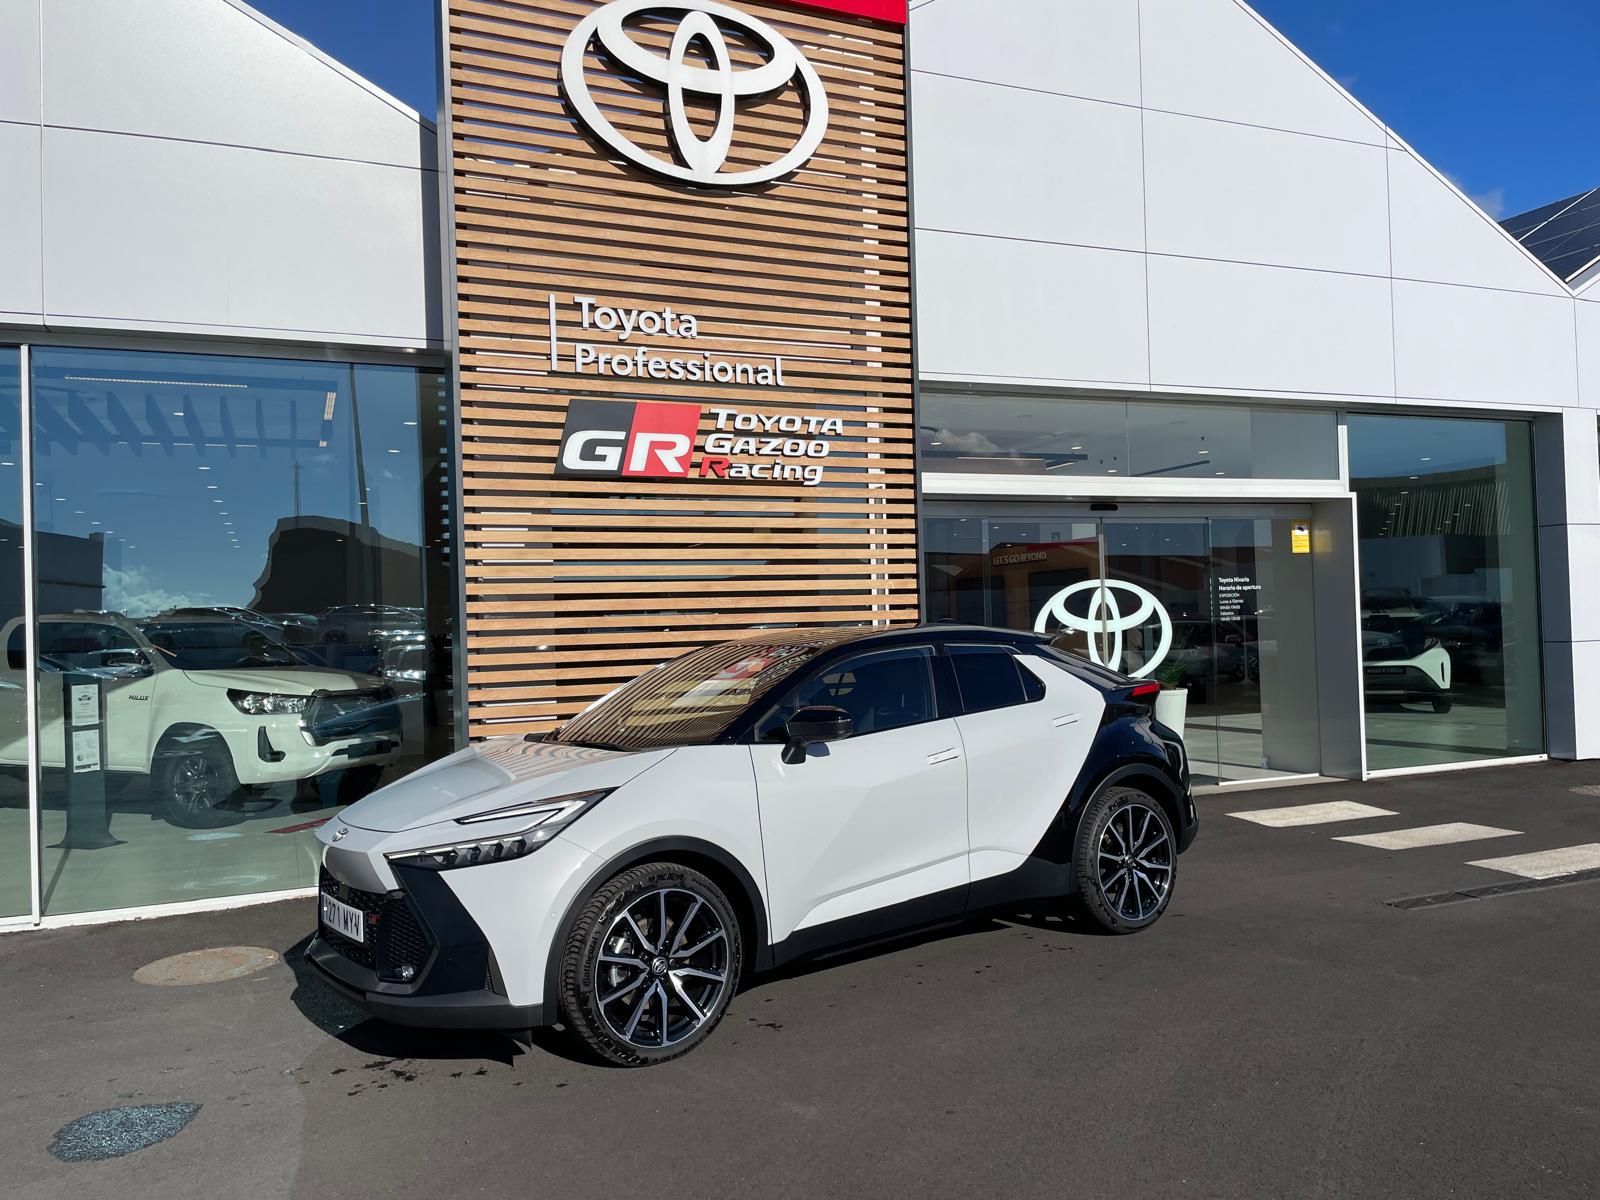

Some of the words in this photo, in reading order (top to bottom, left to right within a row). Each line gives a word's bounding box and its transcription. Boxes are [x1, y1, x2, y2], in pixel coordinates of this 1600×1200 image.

[573, 296, 698, 341] Toyota
[574, 343, 785, 387] Professional
[708, 407, 845, 436] TOYOTA
[562, 429, 691, 474] GR
[703, 433, 831, 459] GAZOO
[698, 456, 825, 486] Racing
[993, 555, 1009, 566] LET'S
[1009, 554, 1020, 564] GO
[1020, 551, 1047, 562] BEYOND
